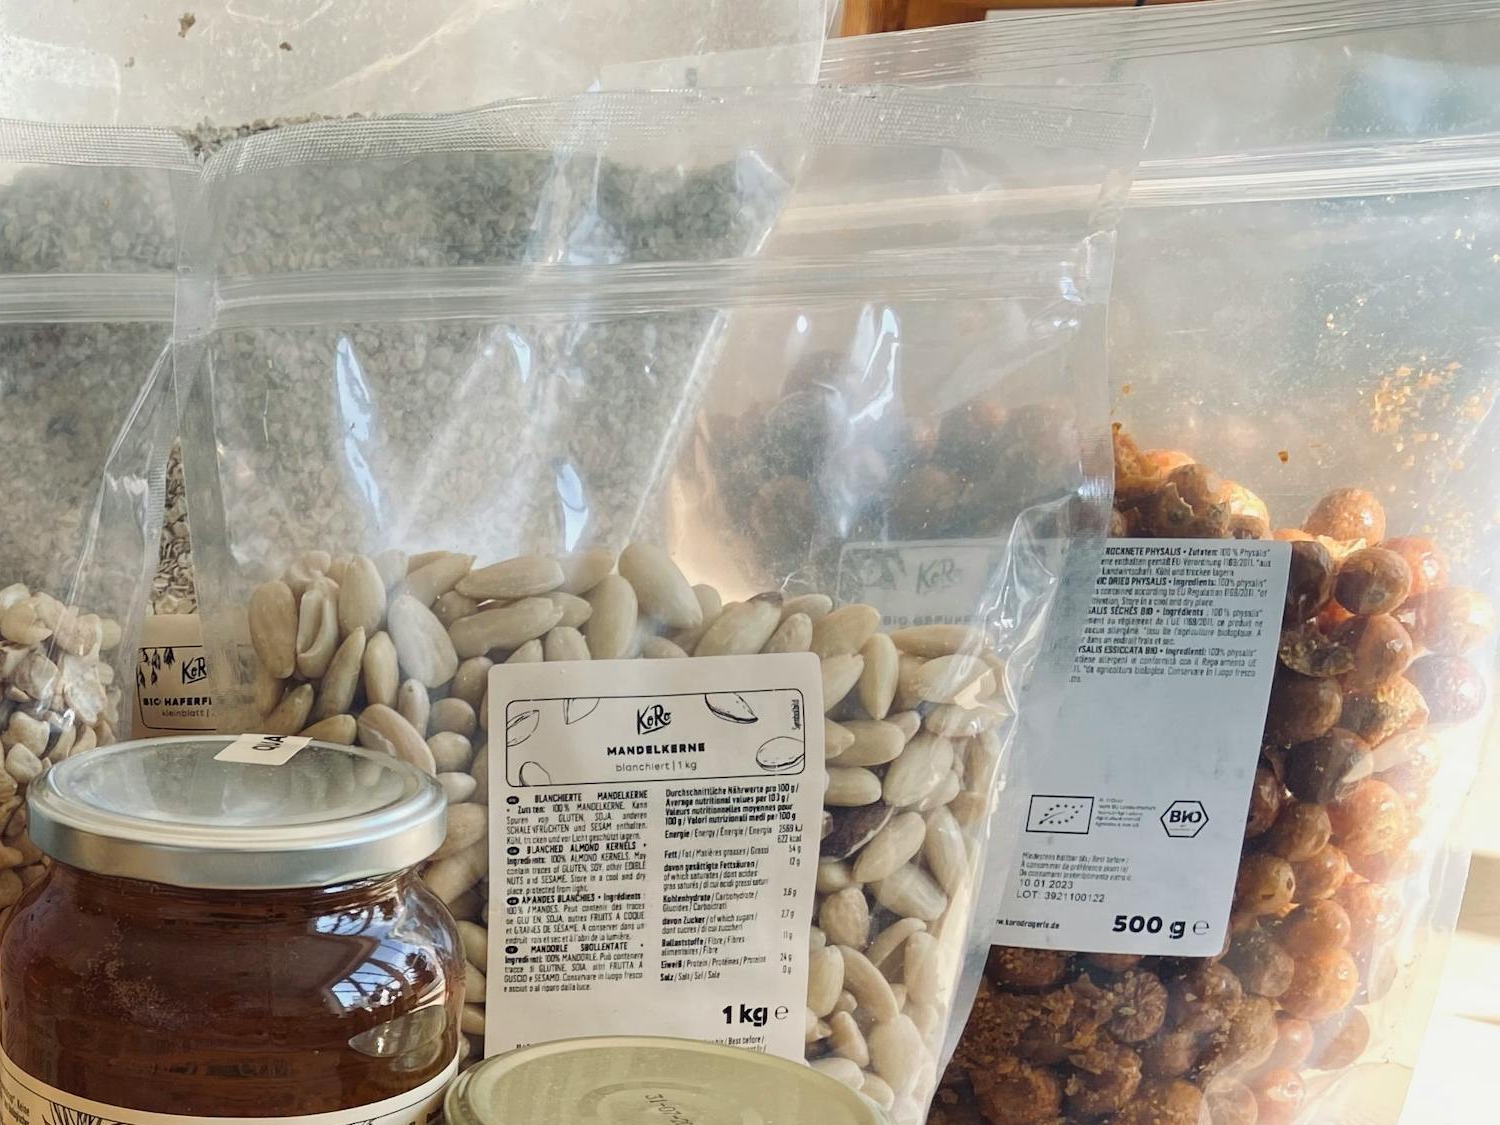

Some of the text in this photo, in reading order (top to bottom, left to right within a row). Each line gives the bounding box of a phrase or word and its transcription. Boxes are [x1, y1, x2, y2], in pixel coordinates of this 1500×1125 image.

[1145, 547, 1181, 556] PHYSALIS
[182, 657, 207, 684] KoR
[637, 704, 671, 735] KoRo
[607, 743, 705, 755] MANDELKERNE
[616, 762, 670, 772] blanchiert
[685, 761, 697, 770] kg
[728, 786, 763, 794] Nährwerte
[1169, 810, 1202, 823] BIO
[1112, 915, 1186, 939] 500 g
[722, 1003, 768, 1028] 1 kg
